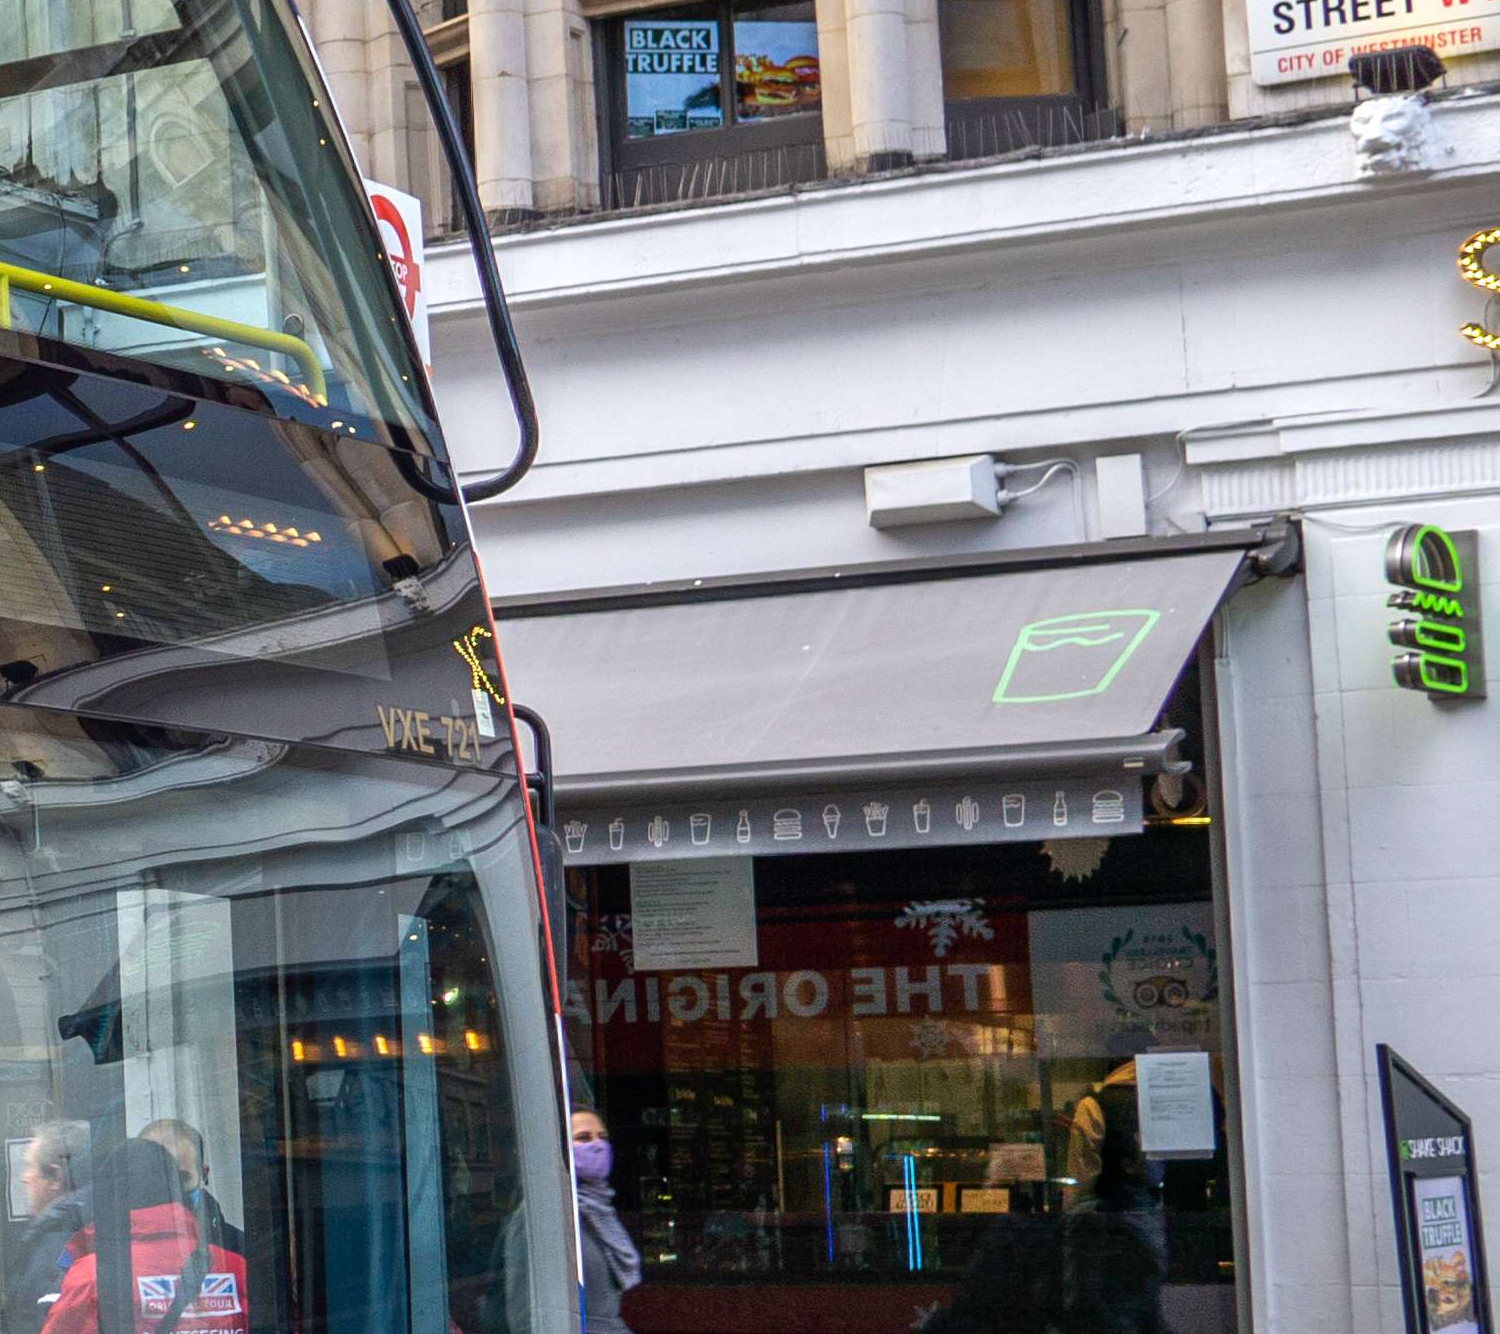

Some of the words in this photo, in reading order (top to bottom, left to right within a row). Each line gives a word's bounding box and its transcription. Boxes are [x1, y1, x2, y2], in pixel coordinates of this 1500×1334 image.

[631, 29, 708, 49] BLACK
[624, 53, 718, 73] TRUFFLE
[1278, 53, 1316, 74] CITY
[1322, 49, 1345, 67] OF
[376, 704, 436, 755] VXE
[440, 715, 482, 764] 721
[1408, 1137, 1436, 1159] SHAKE
[1437, 1136, 1465, 1156] SHACK
[1422, 1198, 1456, 1221] BLACK
[1422, 1223, 1463, 1248] TRUFFLE
